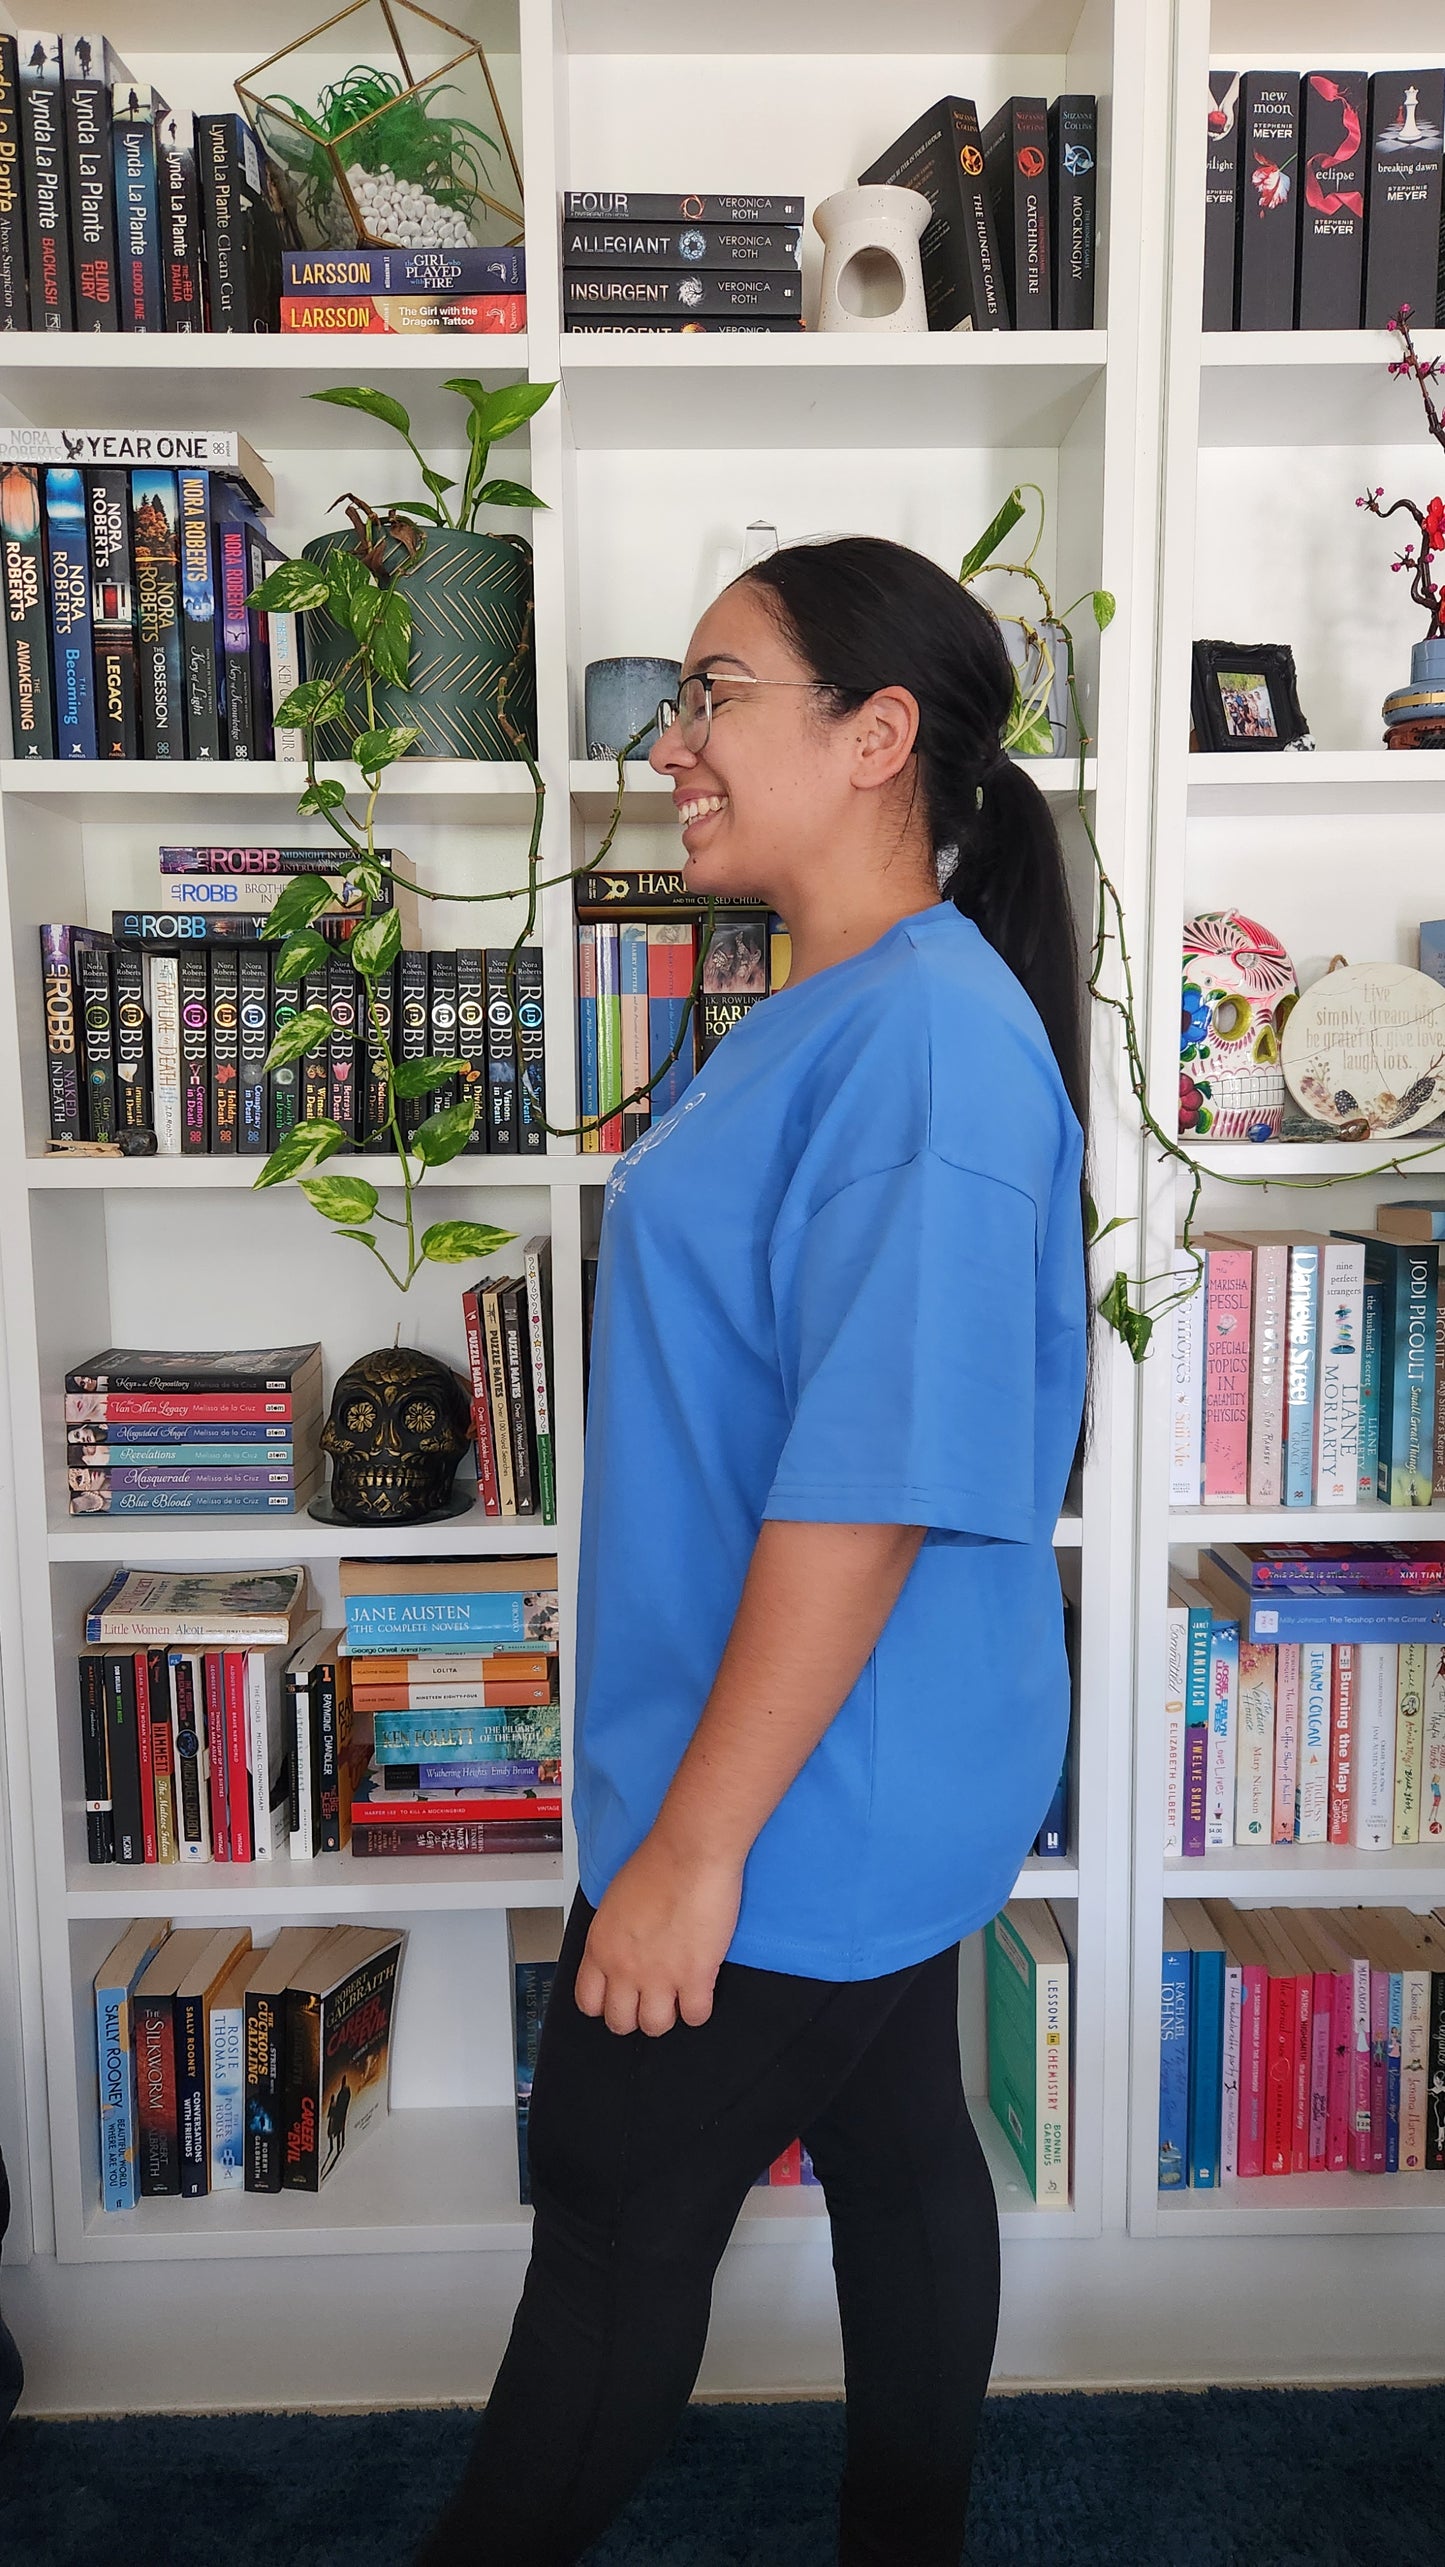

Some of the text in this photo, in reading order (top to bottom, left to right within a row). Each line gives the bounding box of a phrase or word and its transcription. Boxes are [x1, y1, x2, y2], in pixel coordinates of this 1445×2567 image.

[1253, 103, 1294, 118] moon
[1260, 90, 1287, 102] new
[1253, 129, 1293, 138] MEYER
[72, 90, 103, 243] Lynda La Plante
[1315, 168, 1355, 191] eclipse
[1378, 162, 1438, 180] breaking dawn
[29, 90, 60, 306] Lynda La Plante BACKLASH
[570, 193, 628, 212] FOUR
[718, 198, 772, 208] VERONICA
[731, 209, 759, 219] ROTH
[571, 236, 671, 254] ALLEGIANT
[1026, 194, 1040, 295] CATCHING FIRE
[1070, 195, 1083, 281] MOCKINGJAY
[1314, 225, 1354, 235] MEYER
[217, 234, 234, 311] Clean Cut
[291, 262, 371, 285] LARSSON
[406, 266, 462, 279] PLAYED
[414, 254, 448, 266] GIRL
[973, 194, 998, 315] THE HUNGER GAMES
[1, 254, 13, 308] Suspicion
[81, 263, 95, 300] FURY
[94, 260, 110, 303] BLIND
[131, 261, 146, 320] BLOOD LINE
[171, 264, 183, 302] DAHLIA
[182, 276, 194, 302] RED
[424, 278, 454, 289] FIRE
[570, 284, 669, 301] INSURGENT
[290, 307, 370, 328] LARSSON
[399, 306, 478, 317] The Girl with the
[402, 317, 474, 327] Dragon Tattoo
[87, 437, 209, 459] YEAR ONE
[92, 487, 110, 568] ROBERTS
[107, 502, 123, 553] NORA
[182, 478, 209, 583] NORA ROBERTS
[6, 541, 25, 622] ROBERTS
[22, 556, 38, 608] NORA
[52, 551, 72, 635] ROBERTS
[68, 565, 85, 622] NORA
[16, 639, 36, 731] AWAKENING
[64, 648, 81, 726] Becoming
[106, 655, 123, 722] LEGACY
[153, 652, 168, 728] OBSESSION
[209, 849, 281, 873] ROBB
[182, 883, 238, 903] ROBB
[140, 914, 207, 939] ROBB
[45, 964, 75, 1056] J.D. ROBB
[214, 985, 238, 1061] ROBB
[488, 983, 513, 1059] ROBB
[51, 1059, 66, 1124] IN DEATH
[63, 1068, 78, 1118] NAKED
[226, 1088, 236, 1126] Holiday
[503, 1089, 512, 1122] Visions
[217, 1098, 227, 1127] Death
[1209, 1279, 1248, 1291] MARISHA
[1330, 1274, 1358, 1285] perfect
[1335, 1263, 1353, 1271] nine
[1209, 1294, 1249, 1310] PESSL
[1327, 1287, 1362, 1296] strangers
[1288, 1253, 1316, 1405] Danielle Steel
[1407, 1259, 1428, 1383] JODI PICOULT
[468, 1330, 484, 1398] PUZZLE MATES
[1208, 1341, 1247, 1356] SPECIAL
[1208, 1359, 1247, 1374] TOPICS
[1217, 1376, 1236, 1391] IN
[192, 1404, 217, 1412] Melissa
[1206, 1409, 1246, 1423] PHYSICS
[1322, 1365, 1339, 1477] MORIARTY
[1340, 1383, 1359, 1457] LIANE
[124, 1469, 190, 1489] Masquerade
[119, 1491, 192, 1508] Blue Bloods
[1399, 1571, 1442, 1579] XIXI TIAN
[104, 1624, 130, 1635] Little
[131, 1623, 170, 1635] Women
[175, 1623, 204, 1636] Alcott
[350, 1604, 471, 1622] JANE AUSTEN
[353, 1621, 470, 1634] THE COMPLETE NOVELS
[1346, 1616, 1427, 1624] Teashop Corner
[1192, 1632, 1206, 1706] EVANOVICH
[152, 1725, 169, 1774] HAMMETT
[322, 1693, 333, 1776] RAYMOND CHANDLER
[383, 1728, 474, 1748] KEN FOLLETT
[1336, 1671, 1351, 1793] Burning the Map
[1167, 1722, 1178, 1827] ELIZABETH GILBERT
[1190, 1739, 1203, 1821] TWELVE SHARP
[159, 1798, 167, 1830] Maltese
[1047, 1980, 1059, 2031] LESSONS
[1160, 1983, 1174, 2041] JOHNS
[1174, 1982, 1186, 2039] RACHAEL
[104, 2004, 123, 2109] SALLY ROONEY
[145, 2019, 166, 2111] SILKWORM
[247, 2017, 259, 2085] CALLING
[1047, 2048, 1058, 2111] CHEMISTRY
[184, 2098, 193, 2158] WITH FRIENDS
[192, 2091, 203, 2163] CONVERSATIONS
[301, 2096, 315, 2153] CAREER
[287, 2132, 300, 2163] EVIL
[1044, 2123, 1052, 2167] GARMUS
[1053, 2124, 1061, 2165] BONNIE
